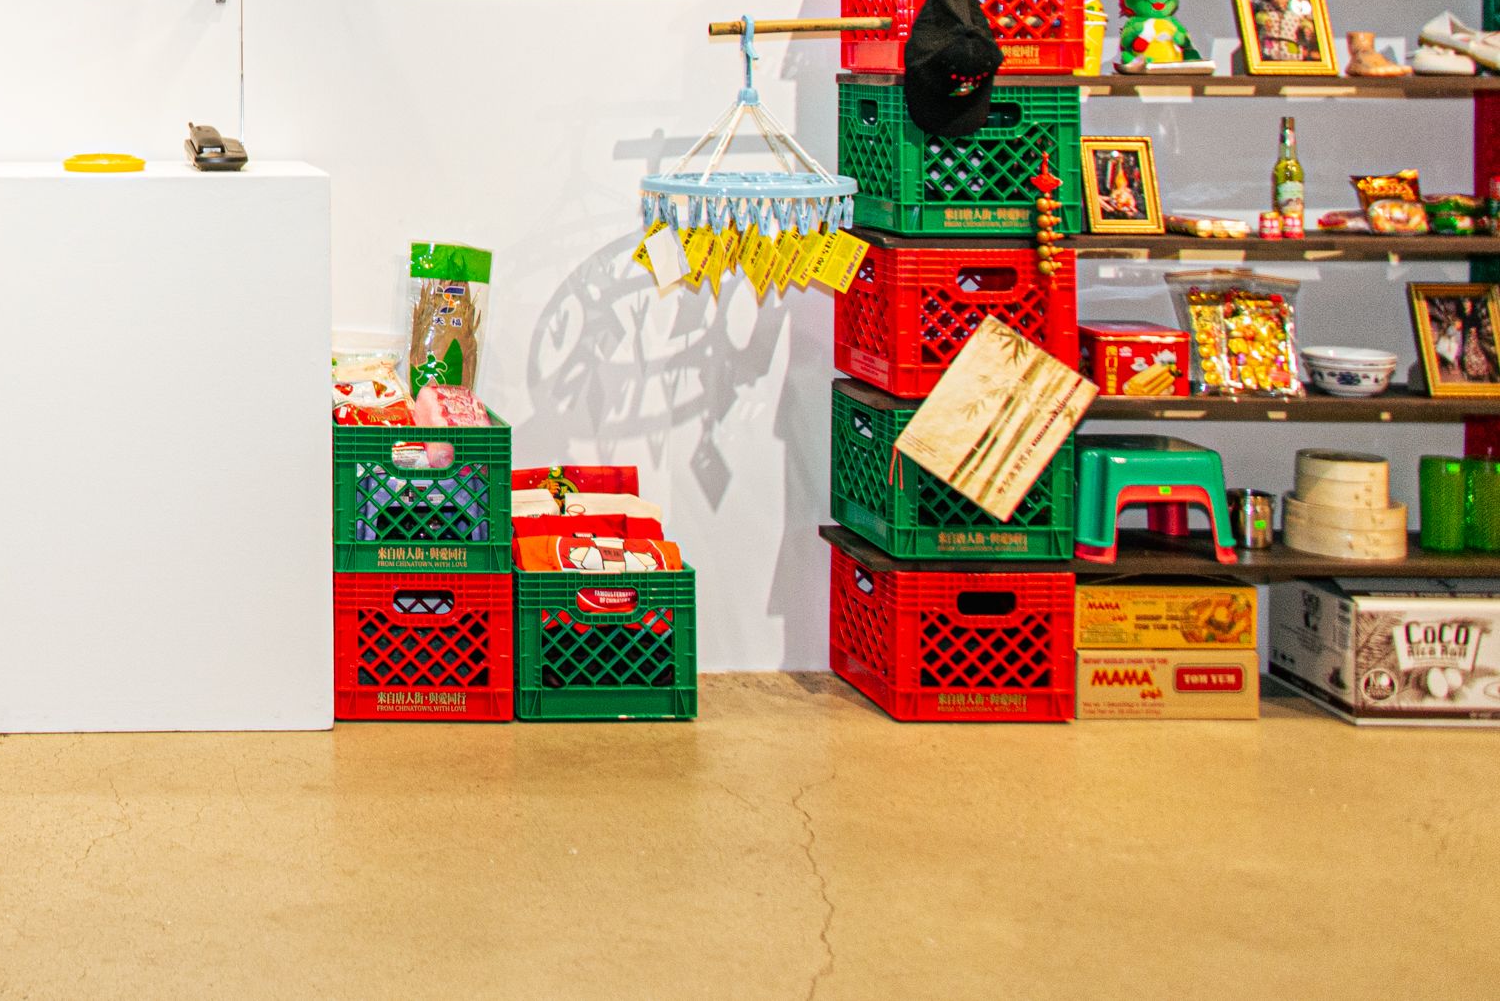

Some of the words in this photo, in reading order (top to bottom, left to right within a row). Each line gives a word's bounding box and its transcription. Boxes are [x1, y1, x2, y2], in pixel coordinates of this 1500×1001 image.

[1088, 602, 1121, 610] MAMA
[1091, 669, 1153, 686] MAMA
[1183, 673, 1208, 685] TOM
[1211, 673, 1236, 685] YUM
